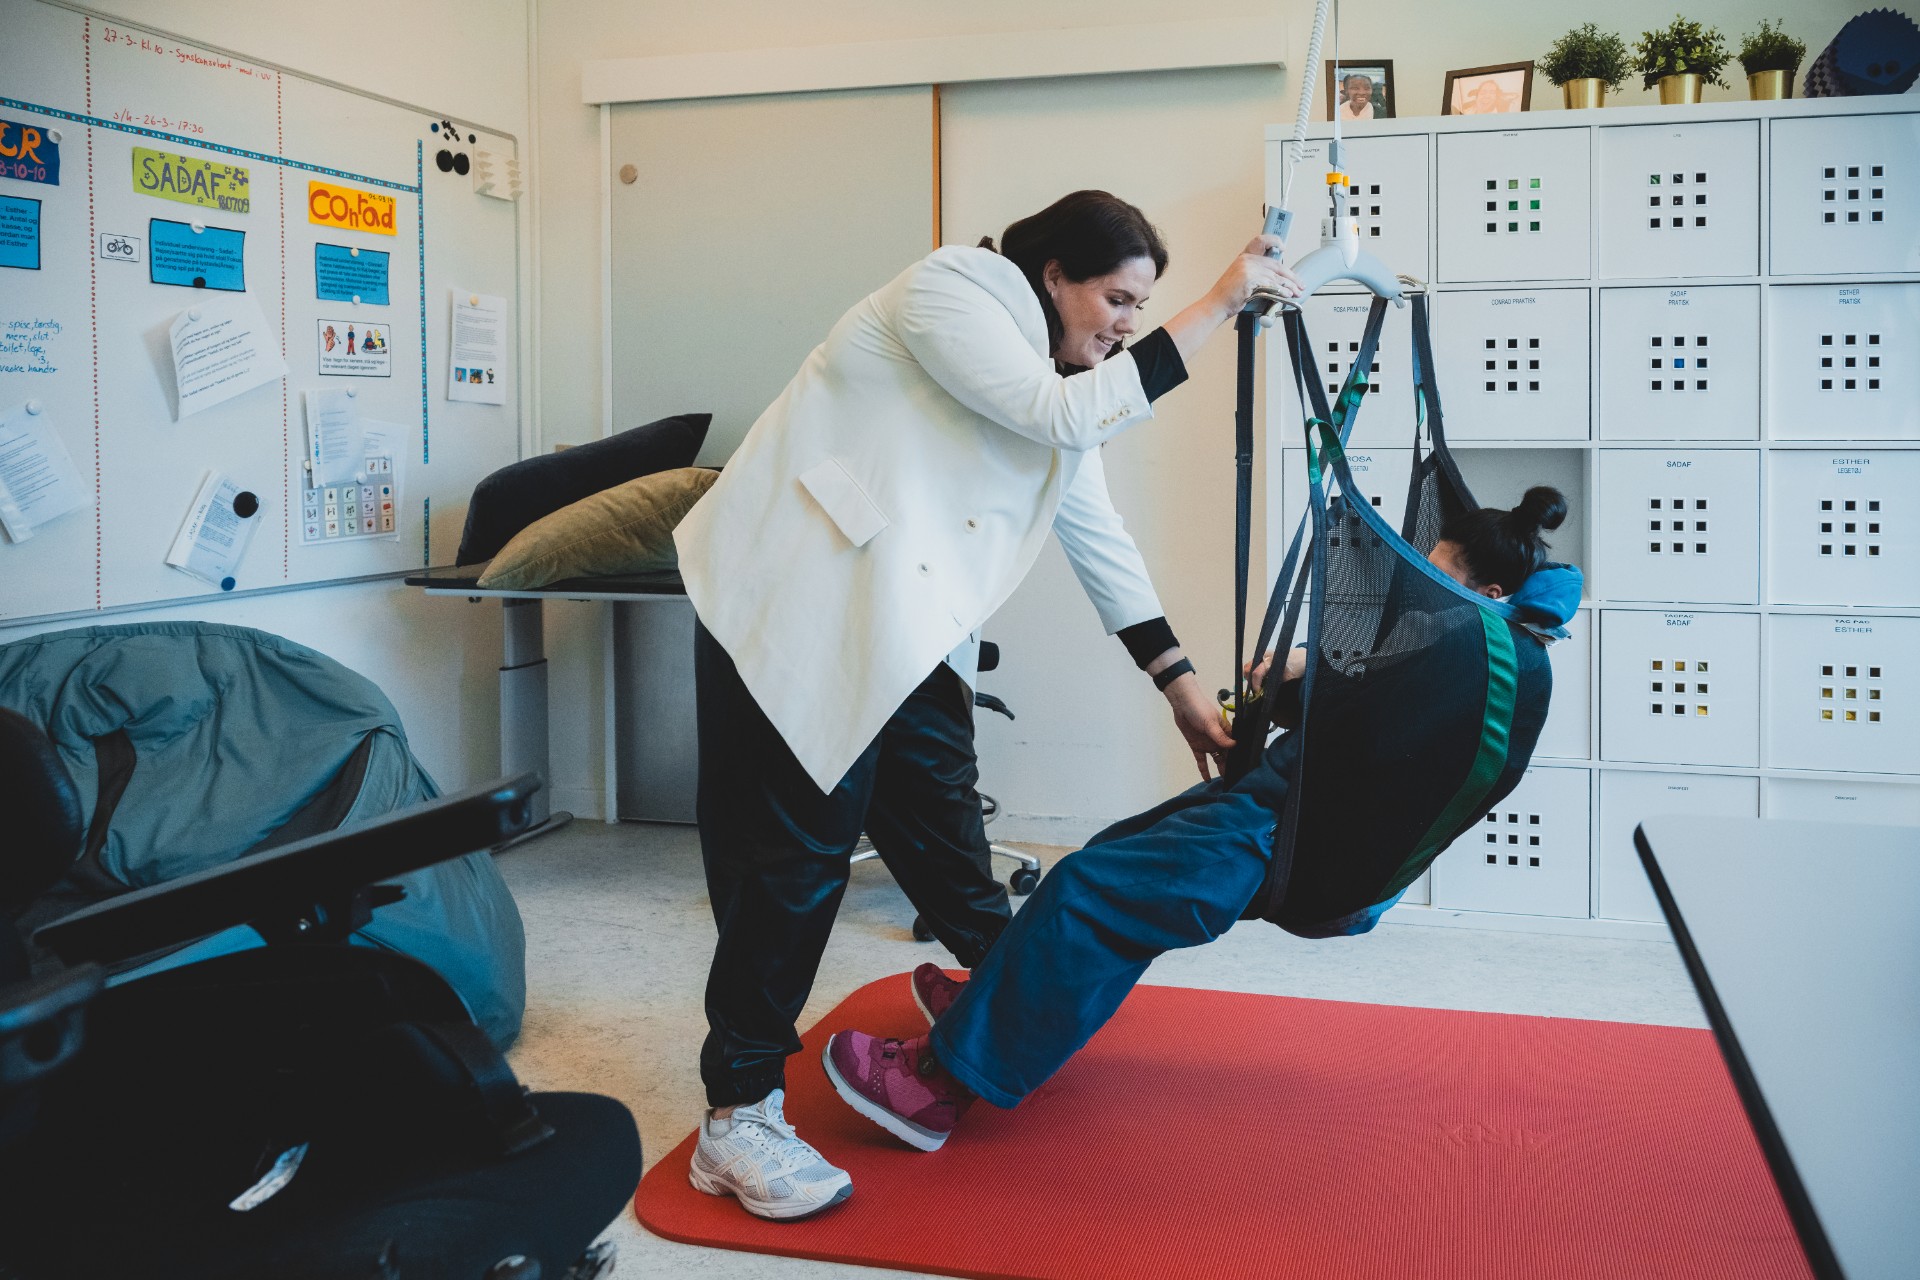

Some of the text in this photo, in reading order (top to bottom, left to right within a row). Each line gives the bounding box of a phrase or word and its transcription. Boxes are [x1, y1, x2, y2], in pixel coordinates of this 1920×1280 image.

[178, 120, 204, 133] 17:30
[139, 156, 226, 201] SADAF
[1839, 288, 1860, 296] ESTHER
[1345, 455, 1372, 463] ROSA
[1666, 460, 1692, 468] SADAF
